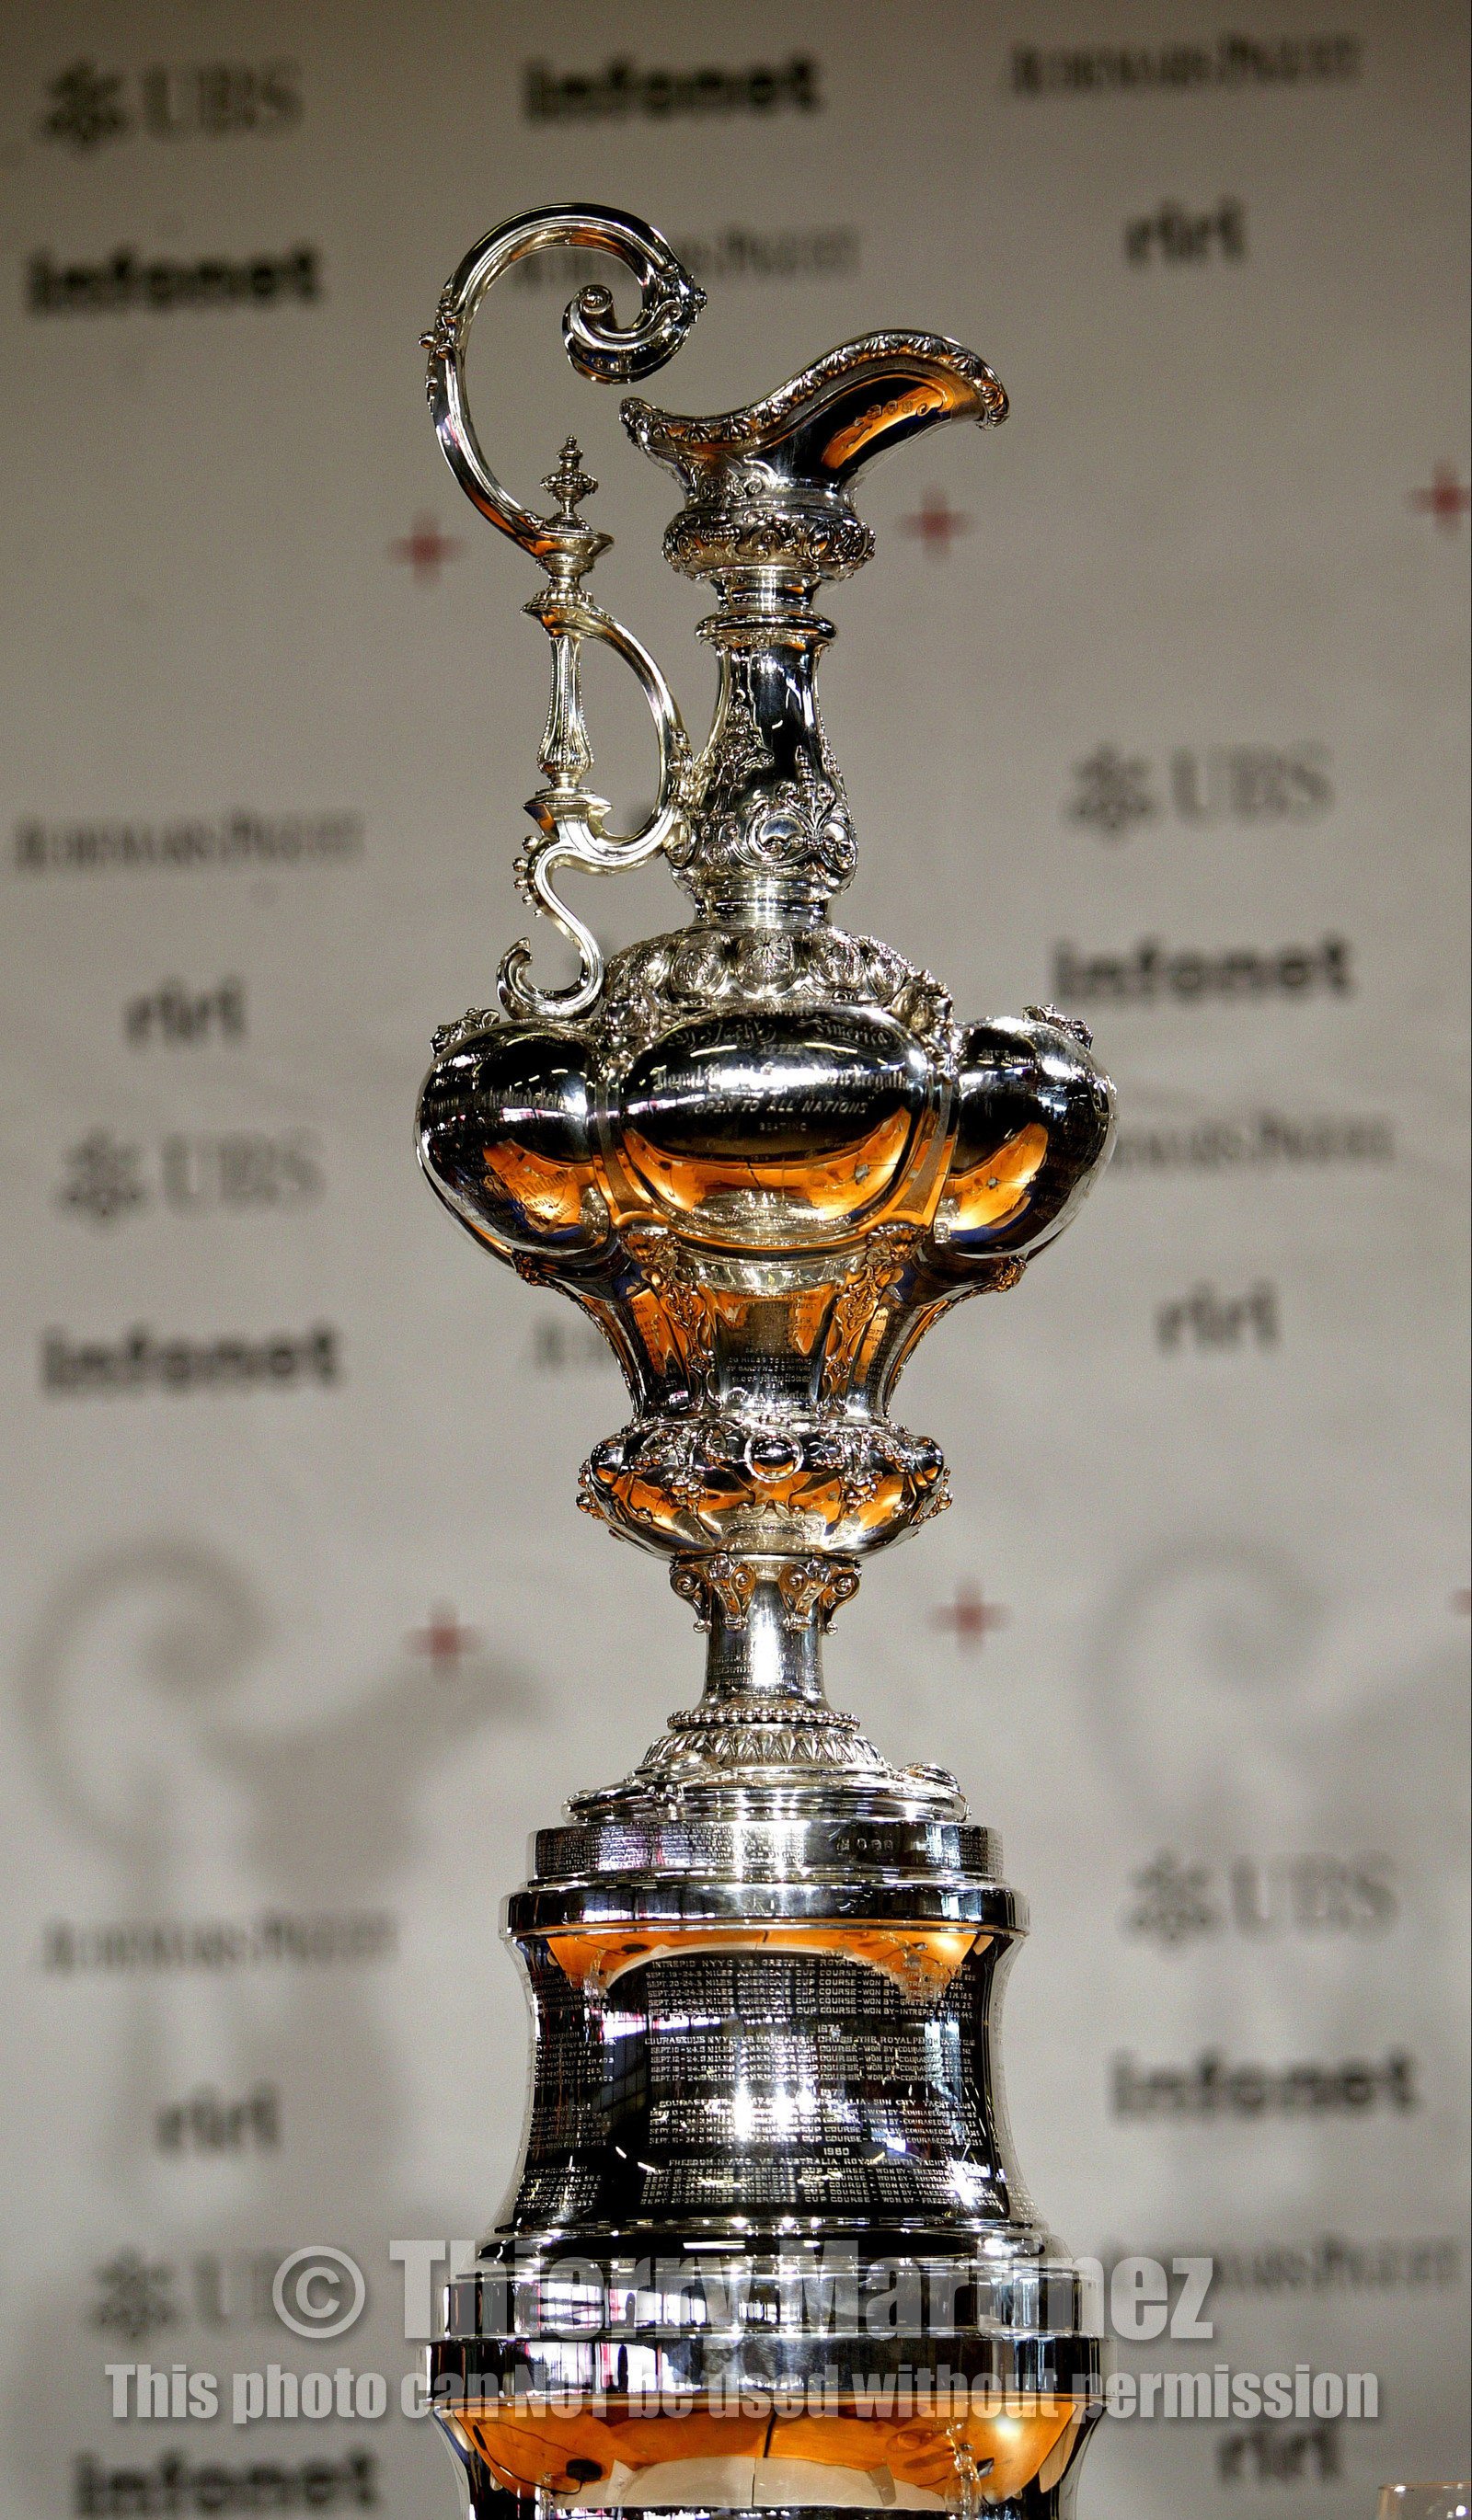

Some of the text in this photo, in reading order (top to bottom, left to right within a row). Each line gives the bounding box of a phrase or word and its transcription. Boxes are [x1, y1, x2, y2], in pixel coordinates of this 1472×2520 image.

[741, 1099, 761, 1112] TO
[766, 1099, 794, 1112] ALL
[652, 1960, 696, 1969] INTREPID
[820, 1959, 853, 1967] ROYAL
[797, 2006, 818, 2014] CUP
[873, 2098, 892, 2106] SUN
[823, 2148, 850, 2156] 1980
